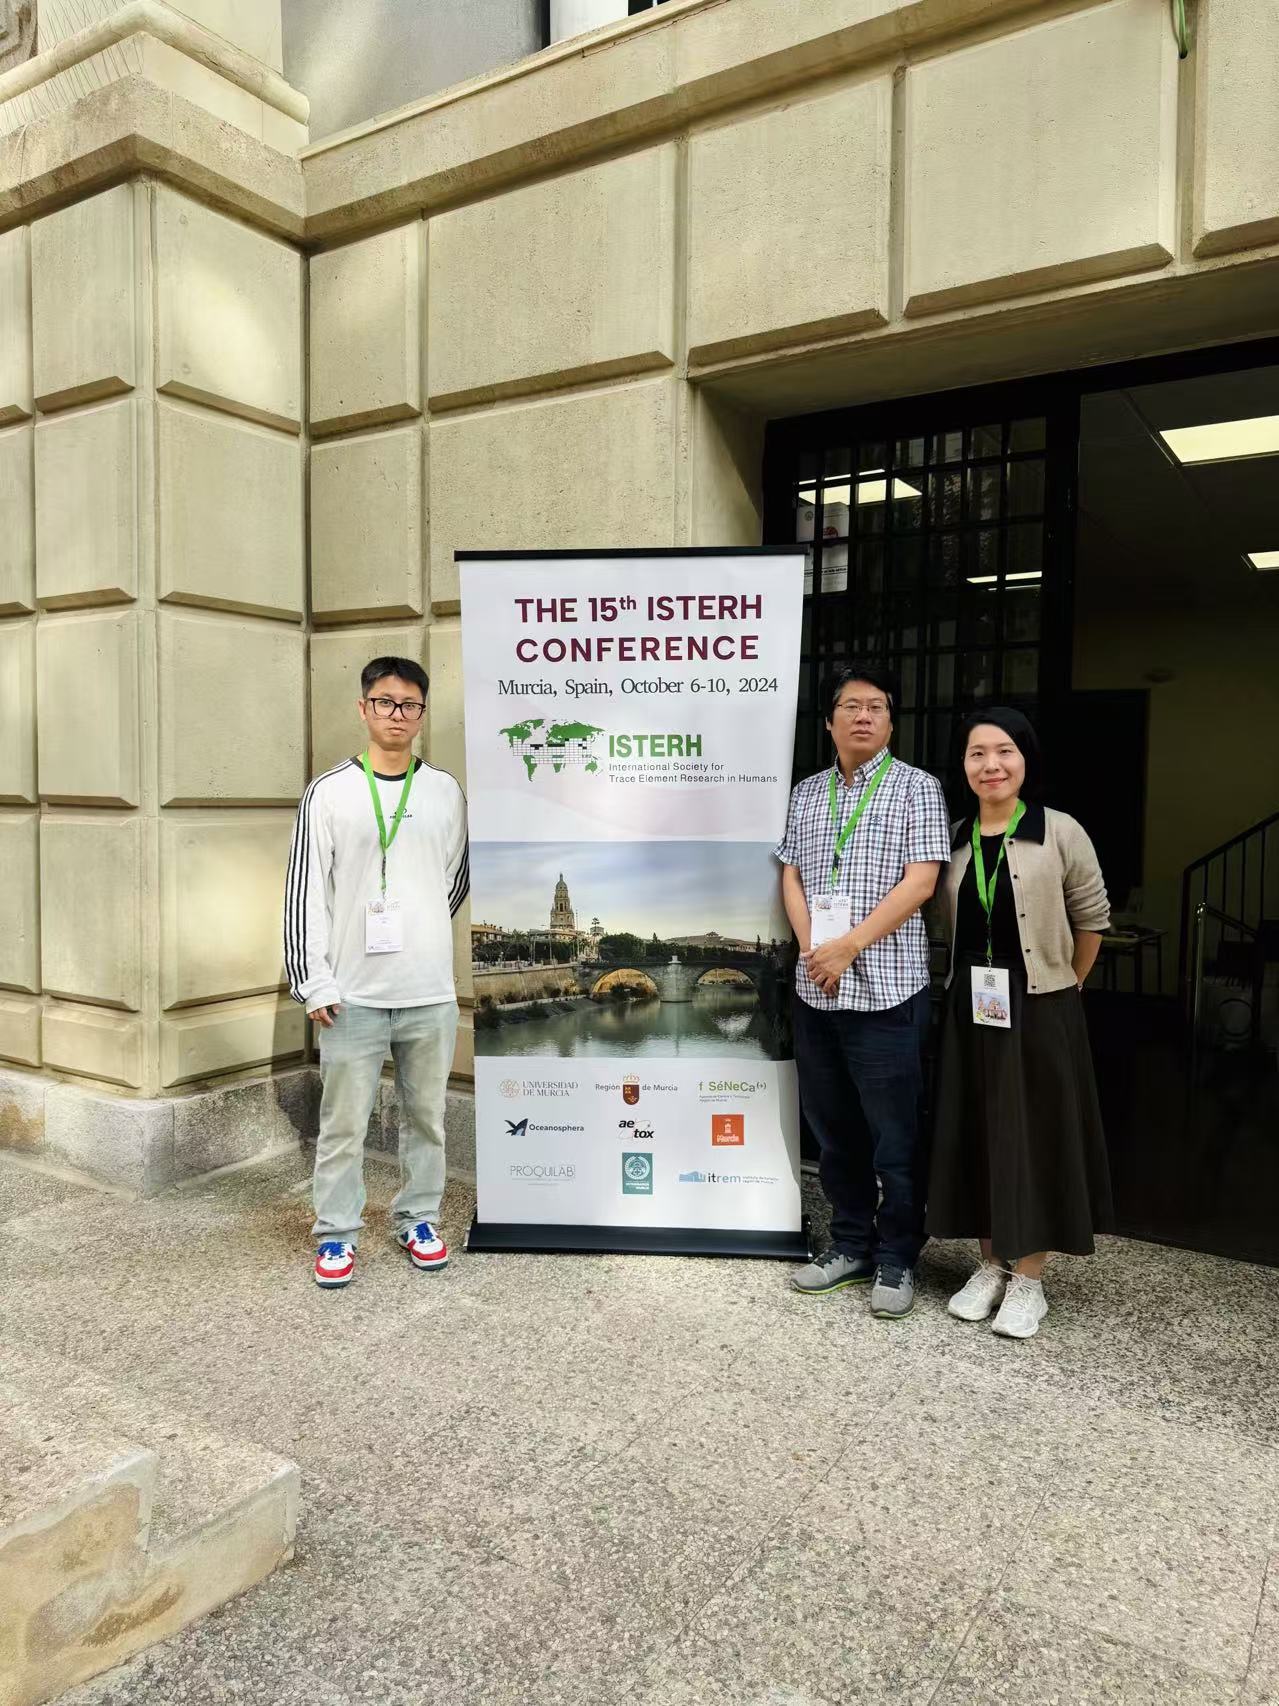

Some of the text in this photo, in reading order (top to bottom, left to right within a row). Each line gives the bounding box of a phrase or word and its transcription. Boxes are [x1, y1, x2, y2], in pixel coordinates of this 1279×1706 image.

[514, 594, 762, 623] THE 15th ISTERH
[516, 635, 759, 663] CONFERENCE
[498, 677, 778, 699] Murcia, Spain, October 6-10, 2024
[609, 734, 703, 757] ISTERH
[609, 762, 724, 774] International Society for
[609, 774, 778, 783] Trace Element Research in Humans
[522, 1081, 579, 1089] UNIVERSIDAD
[595, 1083, 621, 1091] Región
[538, 1089, 570, 1097] MURCIA
[528, 1123, 585, 1132] Oceanosphera
[618, 1120, 635, 1129] ae
[633, 1128, 655, 1139] tox
[707, 1172, 741, 1183] itrem
